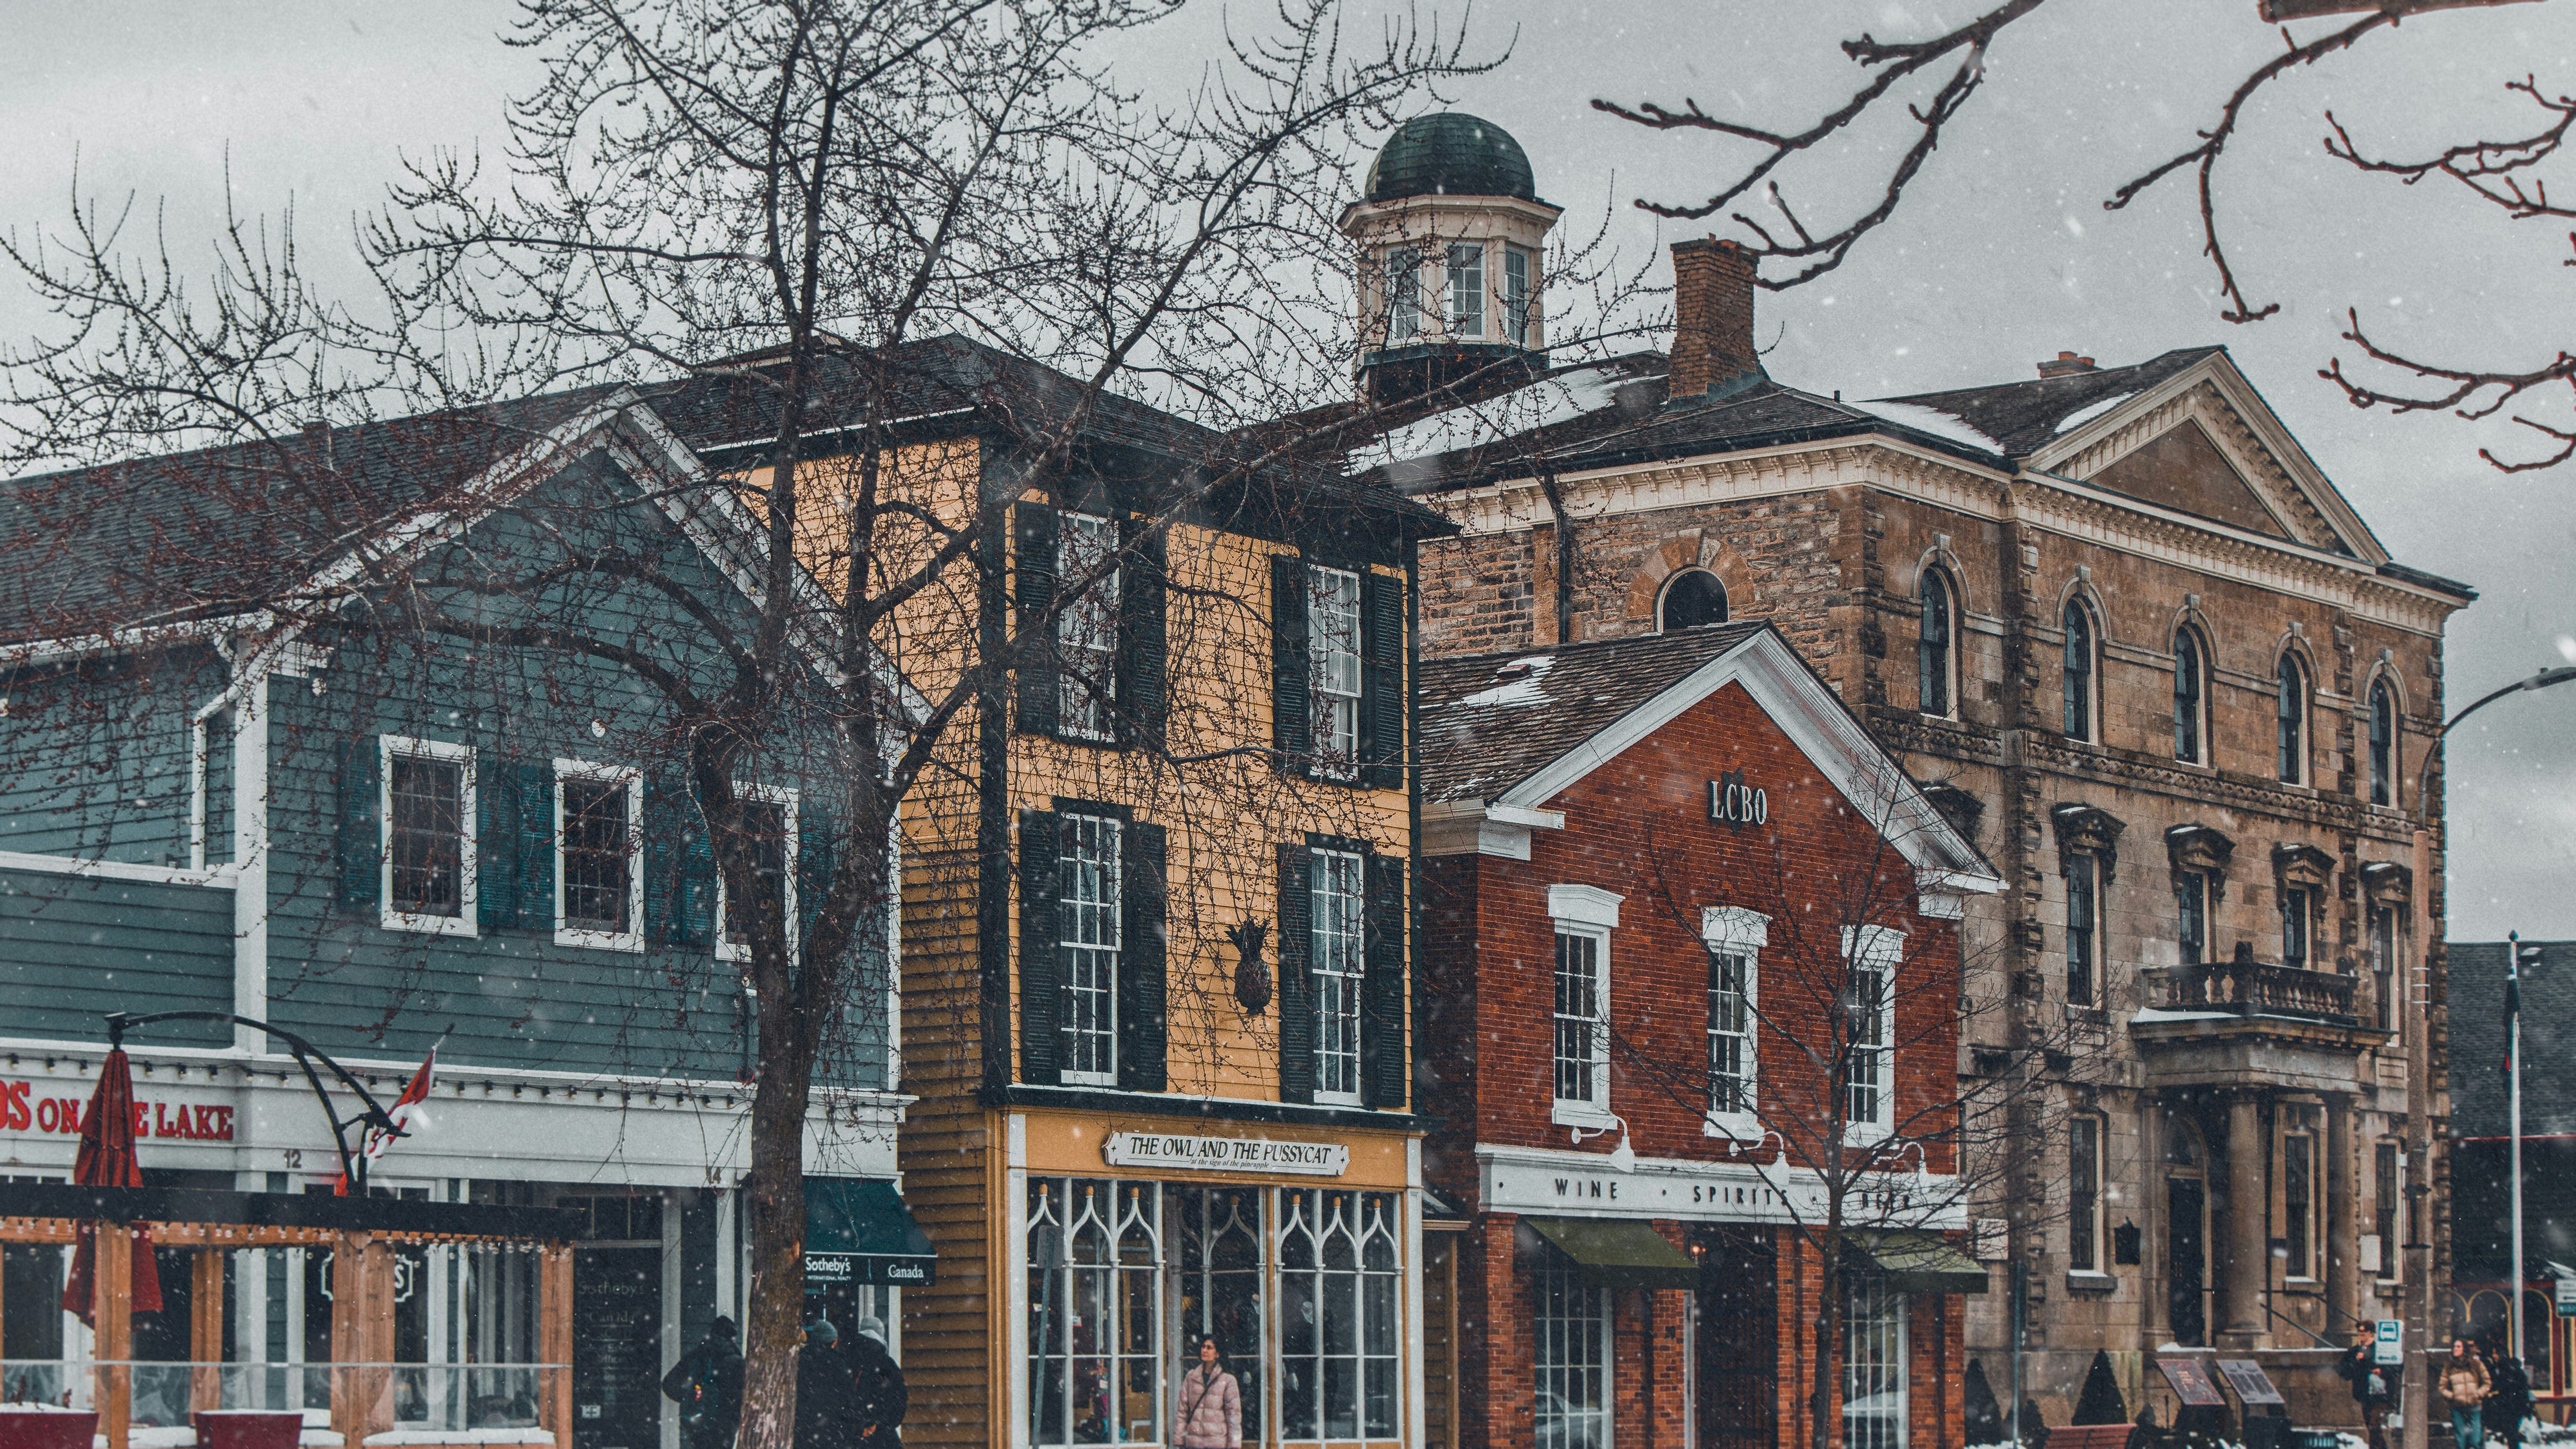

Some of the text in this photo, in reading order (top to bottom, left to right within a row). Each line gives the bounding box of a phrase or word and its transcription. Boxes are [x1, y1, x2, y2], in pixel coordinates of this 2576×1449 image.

[1711, 781, 1767, 825] LCBO
[38, 1098, 80, 1133] ON
[155, 1103, 234, 1140] LAKE
[284, 1148, 301, 1168] 12
[1130, 1137, 1331, 1164] THE OWL AND THE PUSSYCAT
[707, 1166, 722, 1184] 14
[1209, 1159, 1221, 1167] sign
[1240, 1160, 1269, 1170] pineapple
[1555, 1178, 1617, 1199] WINE
[1693, 1185, 1788, 1206] SPIRITS
[805, 1257, 924, 1278] Sotheby's Canada
